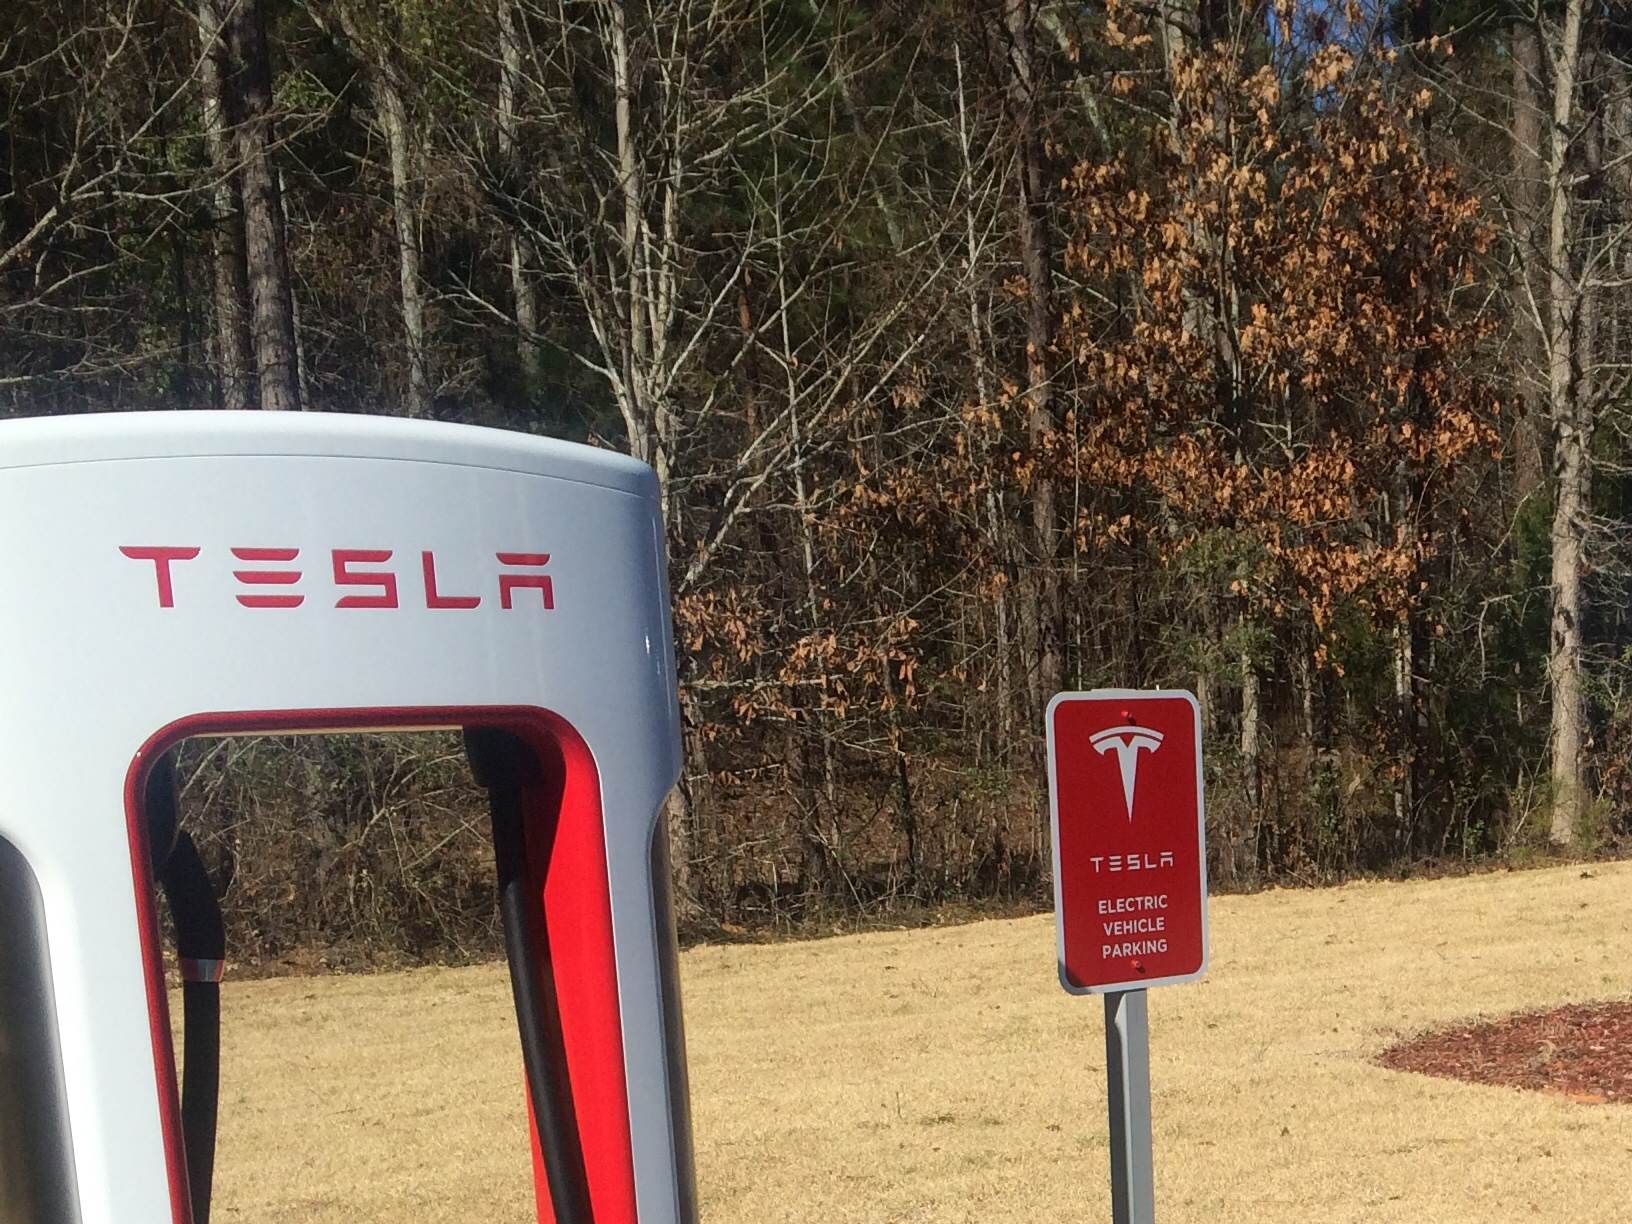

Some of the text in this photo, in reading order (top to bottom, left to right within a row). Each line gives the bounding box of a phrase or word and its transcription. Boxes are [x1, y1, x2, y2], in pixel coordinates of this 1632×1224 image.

[118, 545, 555, 610] TESLA
[1090, 851, 1174, 873] TESLA
[1098, 894, 1168, 915] ELECTRIC
[1103, 917, 1165, 936] VEHICLE
[1102, 938, 1168, 960] PARKING
